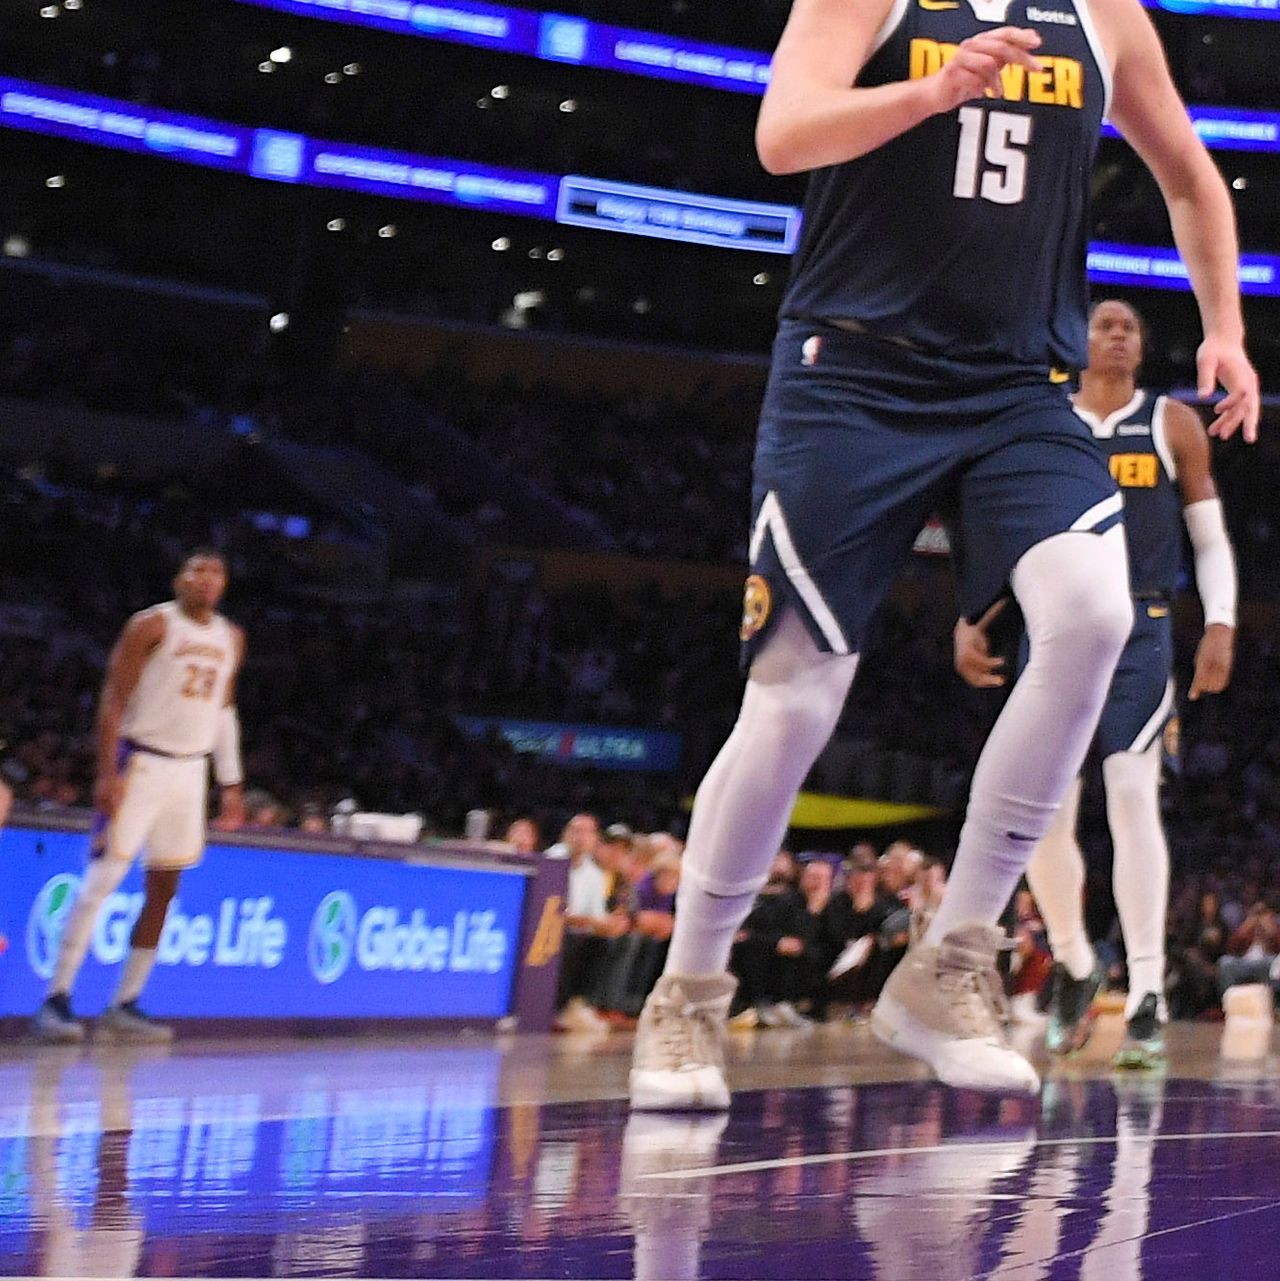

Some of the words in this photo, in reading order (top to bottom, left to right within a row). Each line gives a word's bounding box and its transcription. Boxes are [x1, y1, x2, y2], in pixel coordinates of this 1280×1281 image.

[952, 106, 1033, 205] 15
[213, 895, 288, 969] Life
[357, 905, 449, 972] Globe
[449, 909, 507, 975] Life
